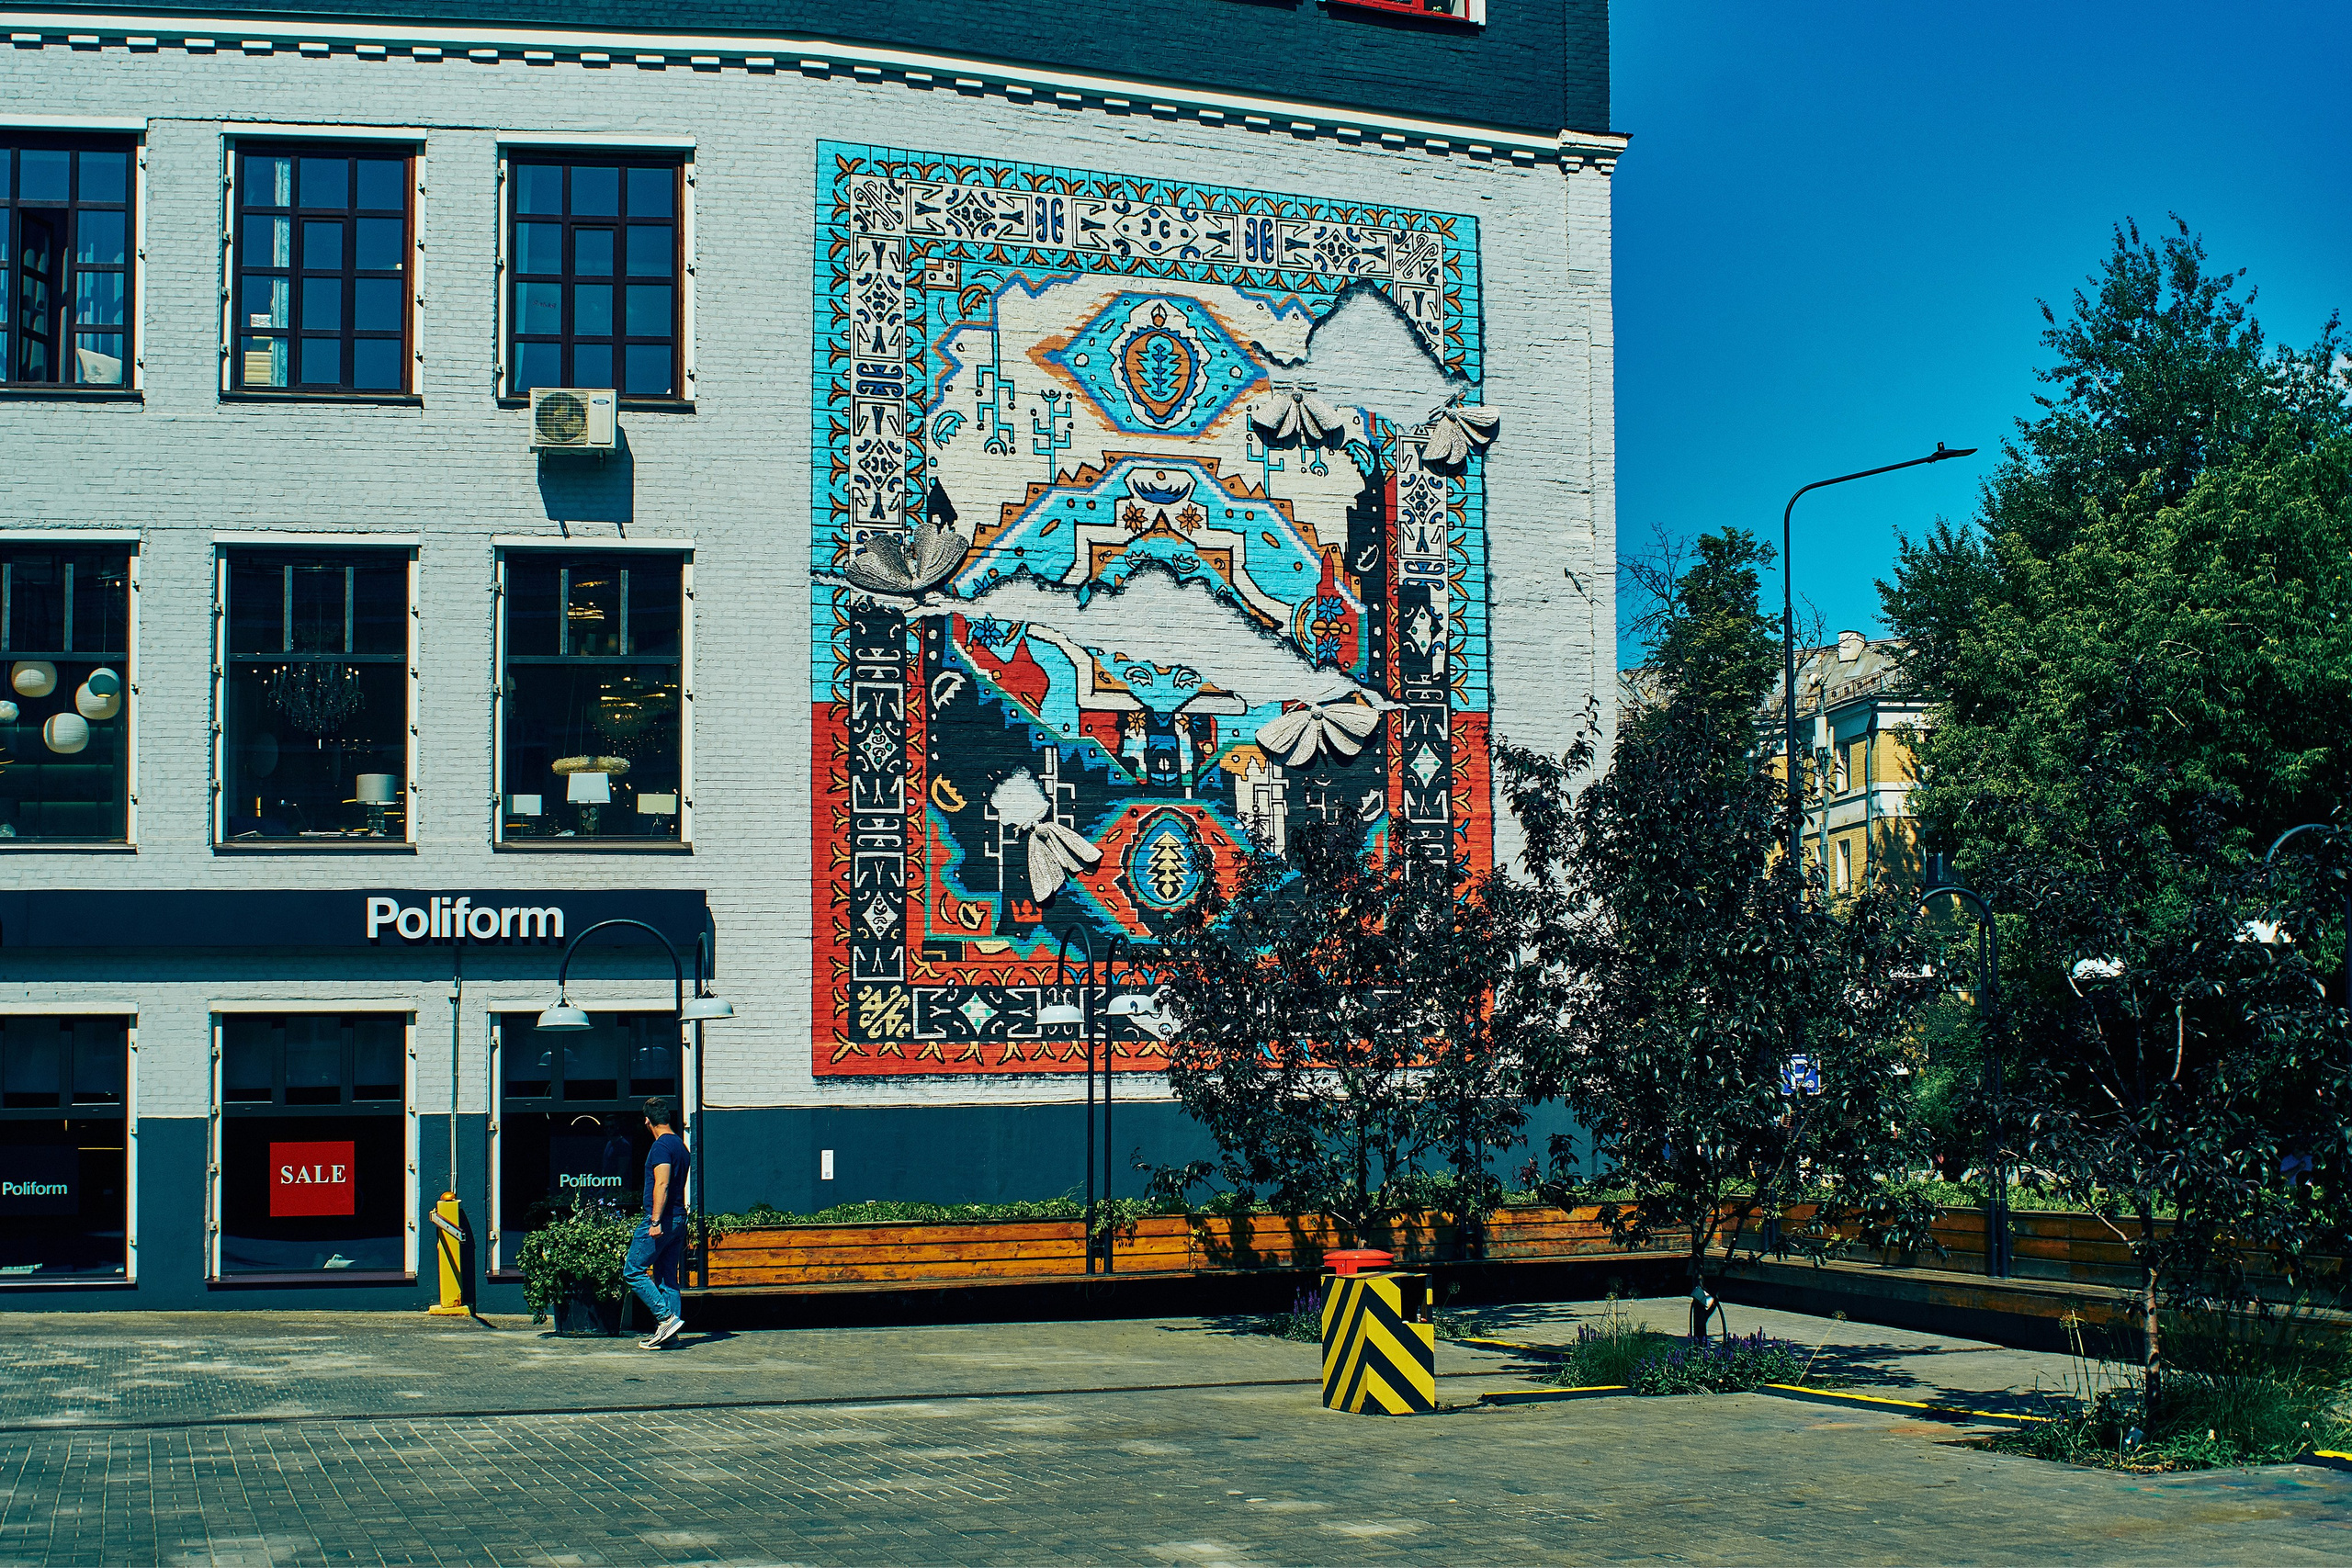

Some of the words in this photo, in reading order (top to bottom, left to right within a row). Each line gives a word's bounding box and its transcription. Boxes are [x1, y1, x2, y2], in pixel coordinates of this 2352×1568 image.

[367, 897, 565, 939] Poliform
[280, 1165, 346, 1185] SALE
[559, 1173, 622, 1188] Poliform
[2, 1181, 68, 1196] Poliform
